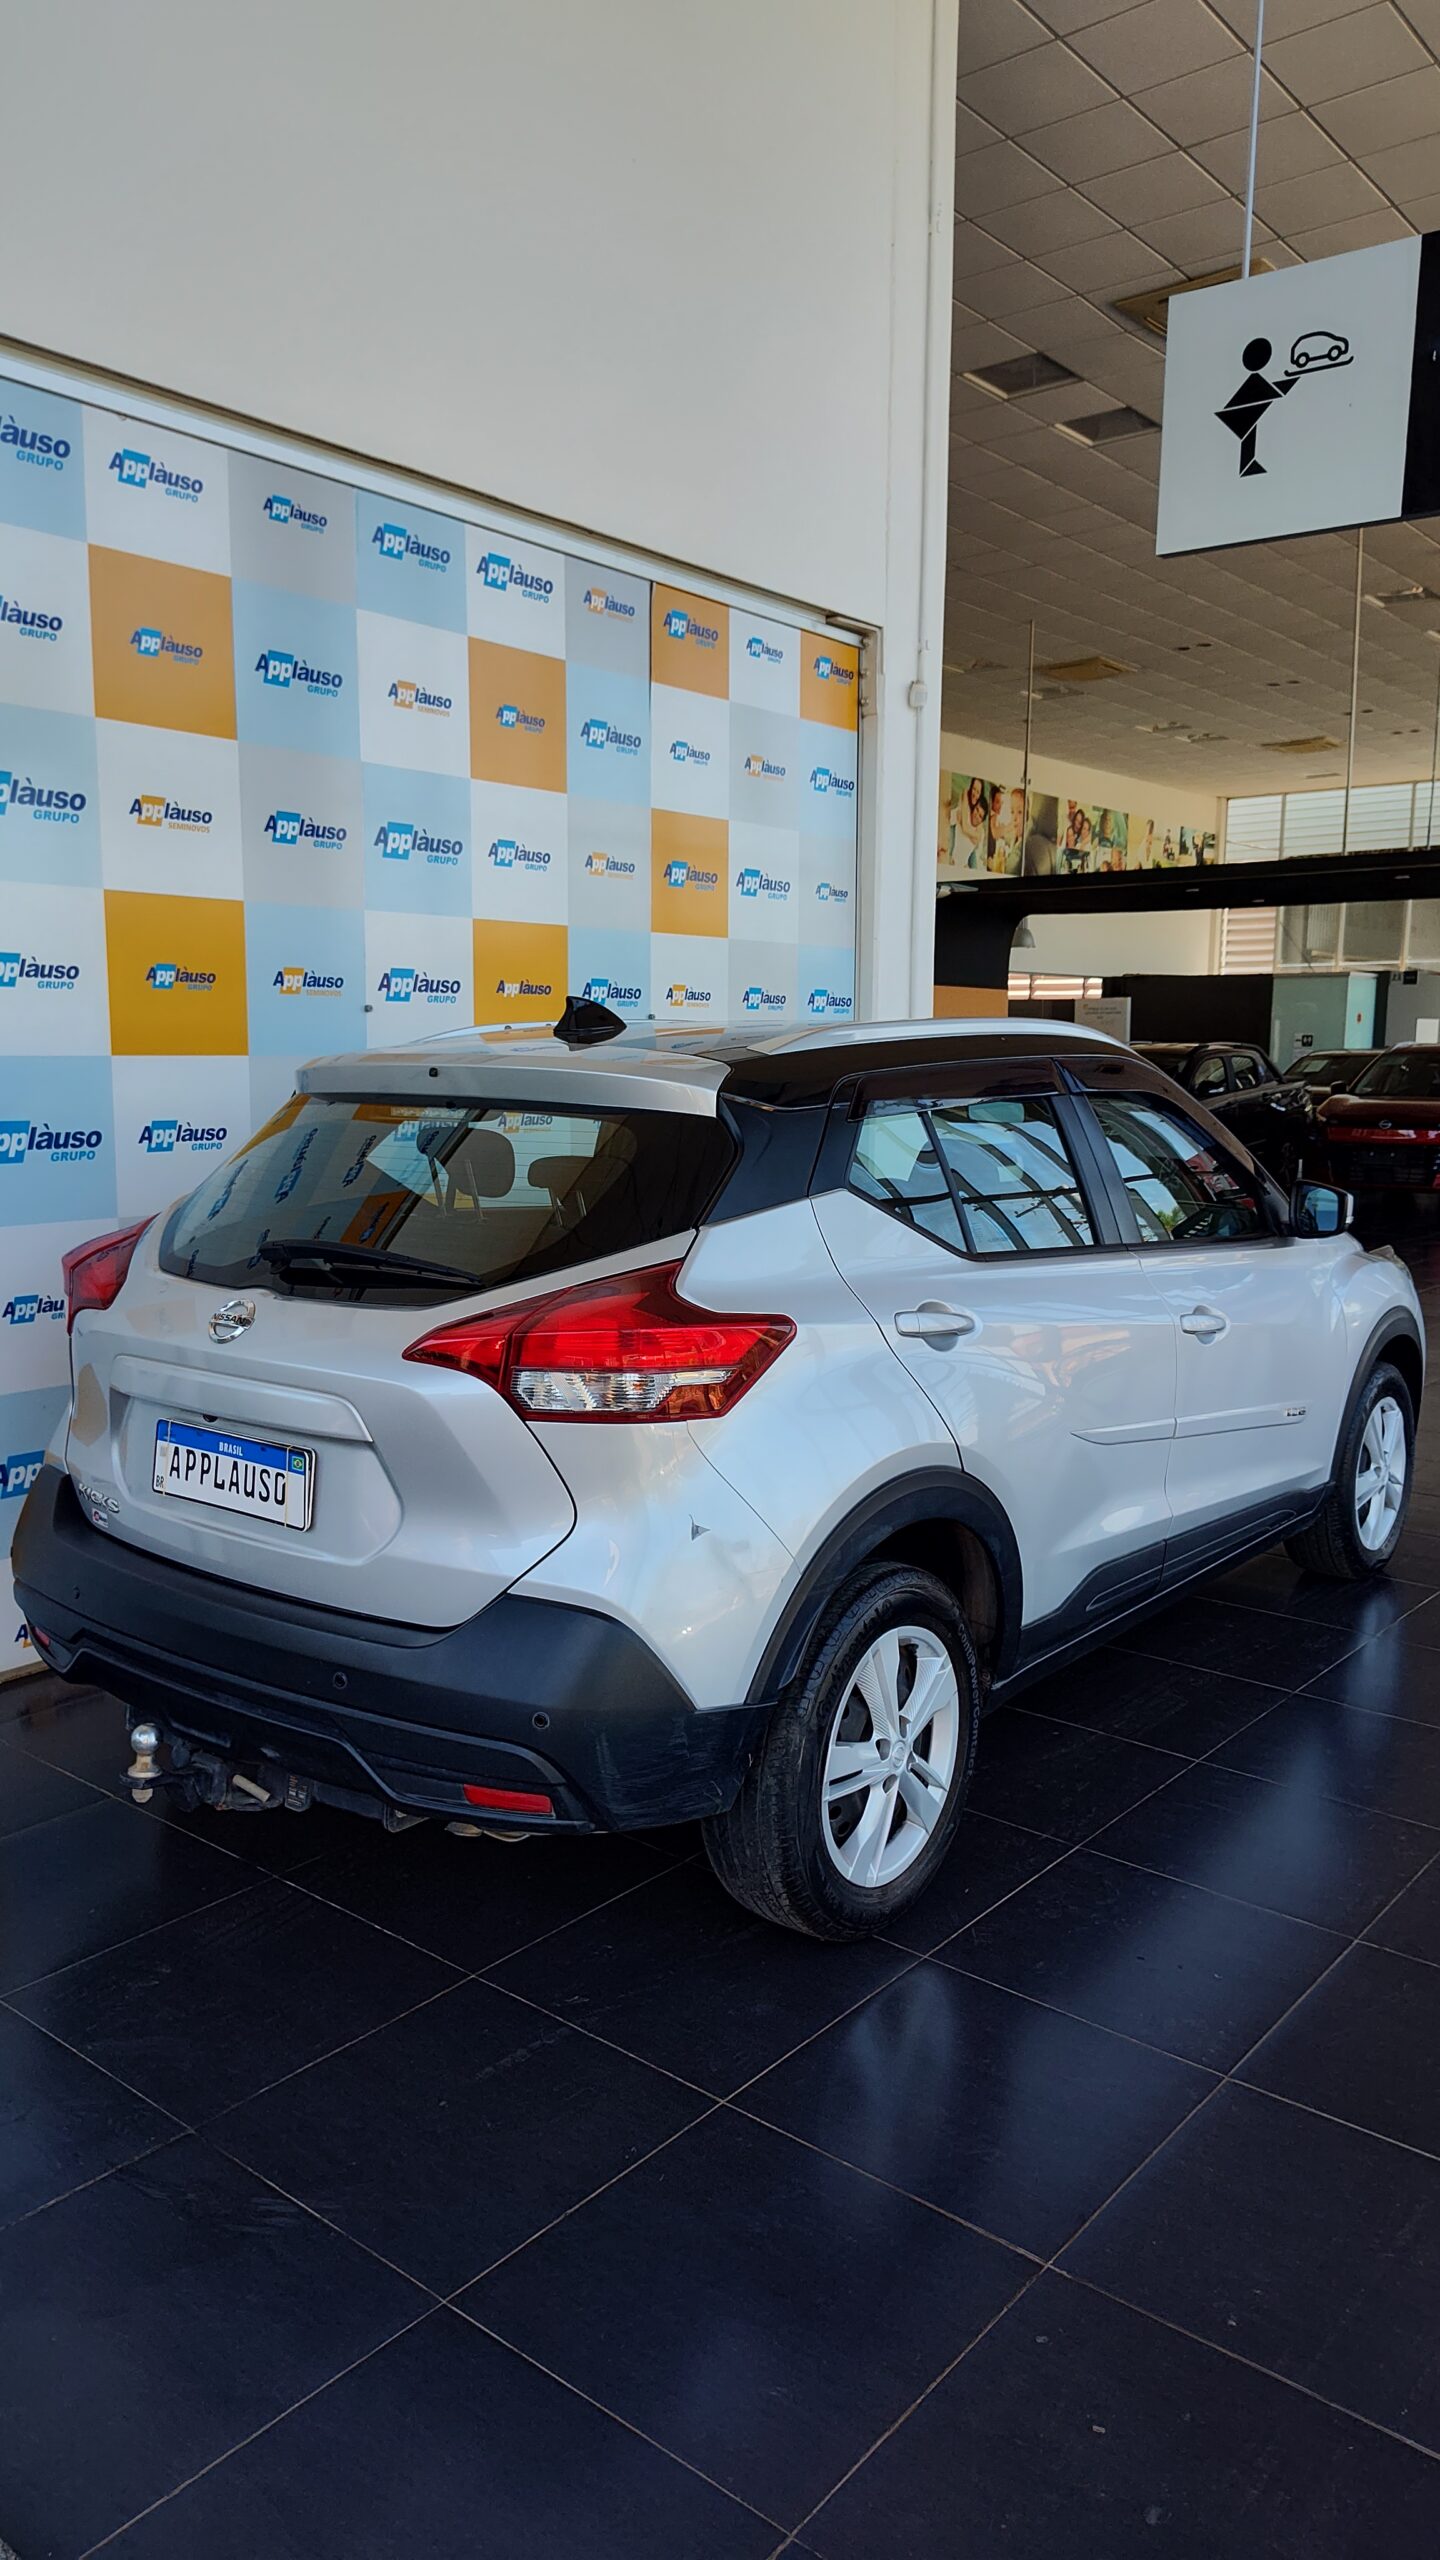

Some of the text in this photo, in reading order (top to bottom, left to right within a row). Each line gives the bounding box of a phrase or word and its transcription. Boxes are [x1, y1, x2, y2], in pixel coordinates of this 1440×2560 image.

[0, 415, 71, 458] àuso
[16, 449, 64, 471] GRUPO
[109, 451, 204, 494] Applàuso
[165, 486, 199, 503] GRUPO
[263, 496, 328, 527] Applàuso
[372, 525, 450, 564] Applàuso
[418, 557, 447, 574] GRUPO
[476, 555, 554, 594] Applàuso
[522, 589, 550, 604] GRUPO
[583, 590, 635, 617] Applàuso
[19, 626, 57, 642] GRUPO
[663, 612, 719, 642] Applàuso
[130, 629, 203, 658] Applàuso
[255, 653, 343, 689] Applàuso
[307, 683, 338, 698] GRUPO
[388, 682, 452, 709] Applàuso
[496, 707, 546, 728] Applàuso
[580, 721, 641, 748] Applàuso
[669, 742, 711, 761] Applàuso
[744, 757, 786, 776] Applàuso
[809, 769, 855, 791] Applàuso
[33, 809, 80, 824] GRUPO
[129, 798, 213, 824] Applàuso
[263, 814, 347, 841] Applàuso
[313, 840, 343, 850] GRUPO
[374, 826, 463, 855] Applàuso
[426, 854, 458, 866] GRUPO
[488, 842, 551, 865] Applàuso
[585, 855, 636, 873] Applàuso
[663, 863, 718, 885] Applàuso
[736, 871, 791, 893] Applàuso
[37, 980, 74, 990] GRUPO
[146, 966, 216, 985] Applàuso
[273, 970, 344, 991] Applàuso
[378, 972, 461, 997] Applàuso
[496, 979, 552, 998] Applàuso
[582, 981, 642, 1003] Applàuso
[666, 986, 712, 1003] Applàuso
[743, 989, 786, 1007] Applàuso
[426, 995, 457, 1004] GRUPO
[808, 991, 852, 1008] Applàuso
[139, 1121, 227, 1148] Applàuso
[51, 1150, 96, 1162] GRUPO
[191, 1142, 223, 1151] GRUPO
[213, 1312, 246, 1326] NISSAN
[219, 1442, 244, 1457] BRASIL
[156, 1475, 165, 1488] BR
[169, 1446, 286, 1506] APPLAUSO
